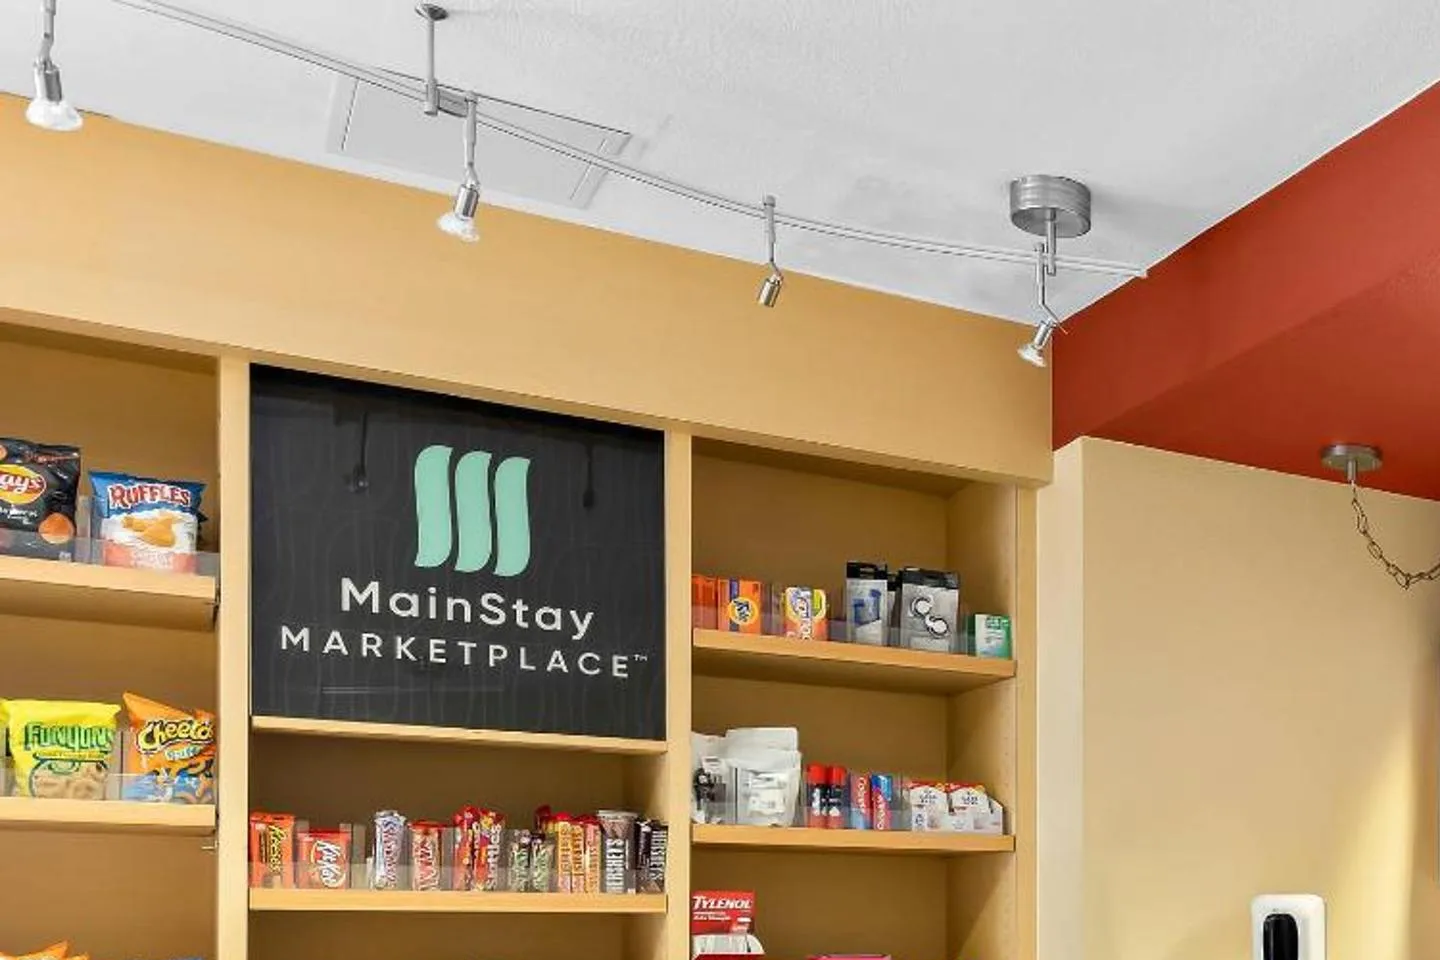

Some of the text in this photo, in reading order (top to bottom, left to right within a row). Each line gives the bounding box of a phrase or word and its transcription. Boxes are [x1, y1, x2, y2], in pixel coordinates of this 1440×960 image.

[0, 472, 42, 494] ay's
[107, 483, 191, 509] RUFFLES
[340, 576, 595, 640] MainStay
[692, 895, 752, 910] TYLENOL
